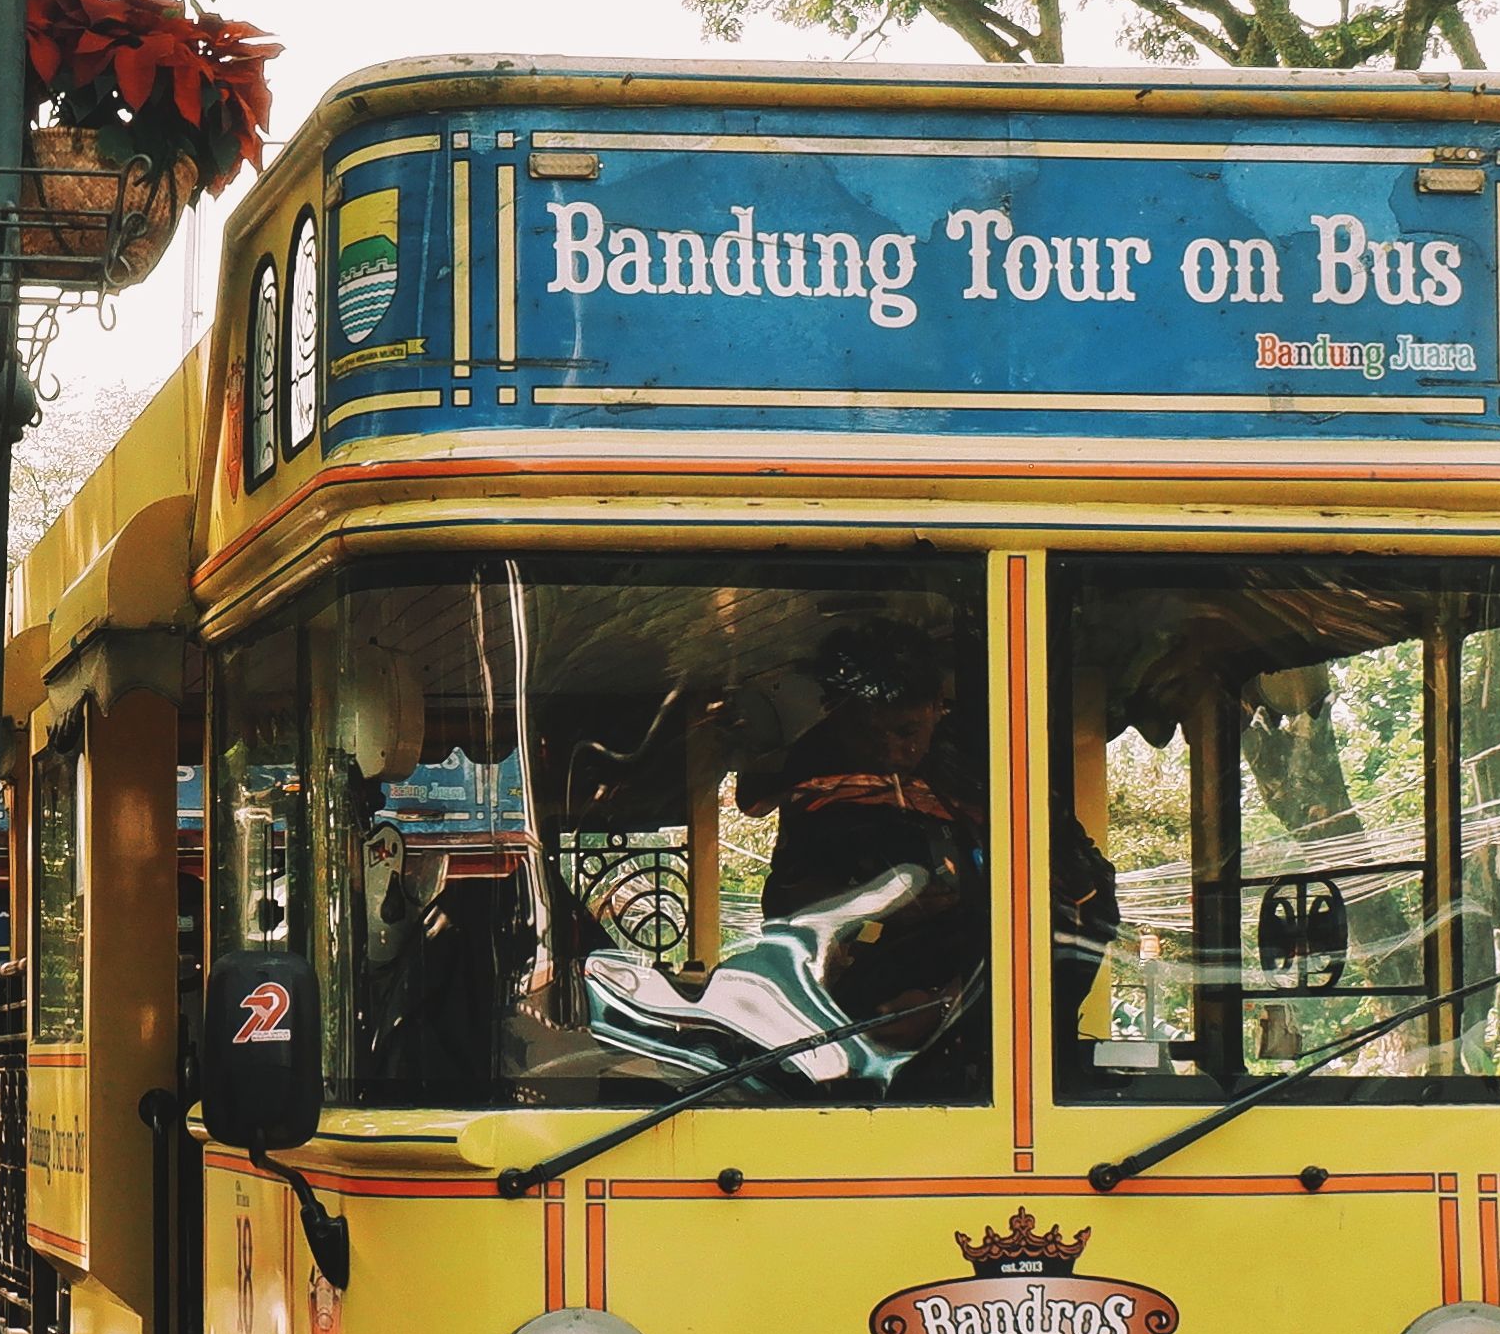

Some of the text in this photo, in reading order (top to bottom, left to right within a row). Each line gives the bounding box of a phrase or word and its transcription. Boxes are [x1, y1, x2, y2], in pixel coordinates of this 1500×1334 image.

[546, 201, 1461, 327] Bandung Tour on Bus
[1256, 333, 1476, 380] Bandung Juara
